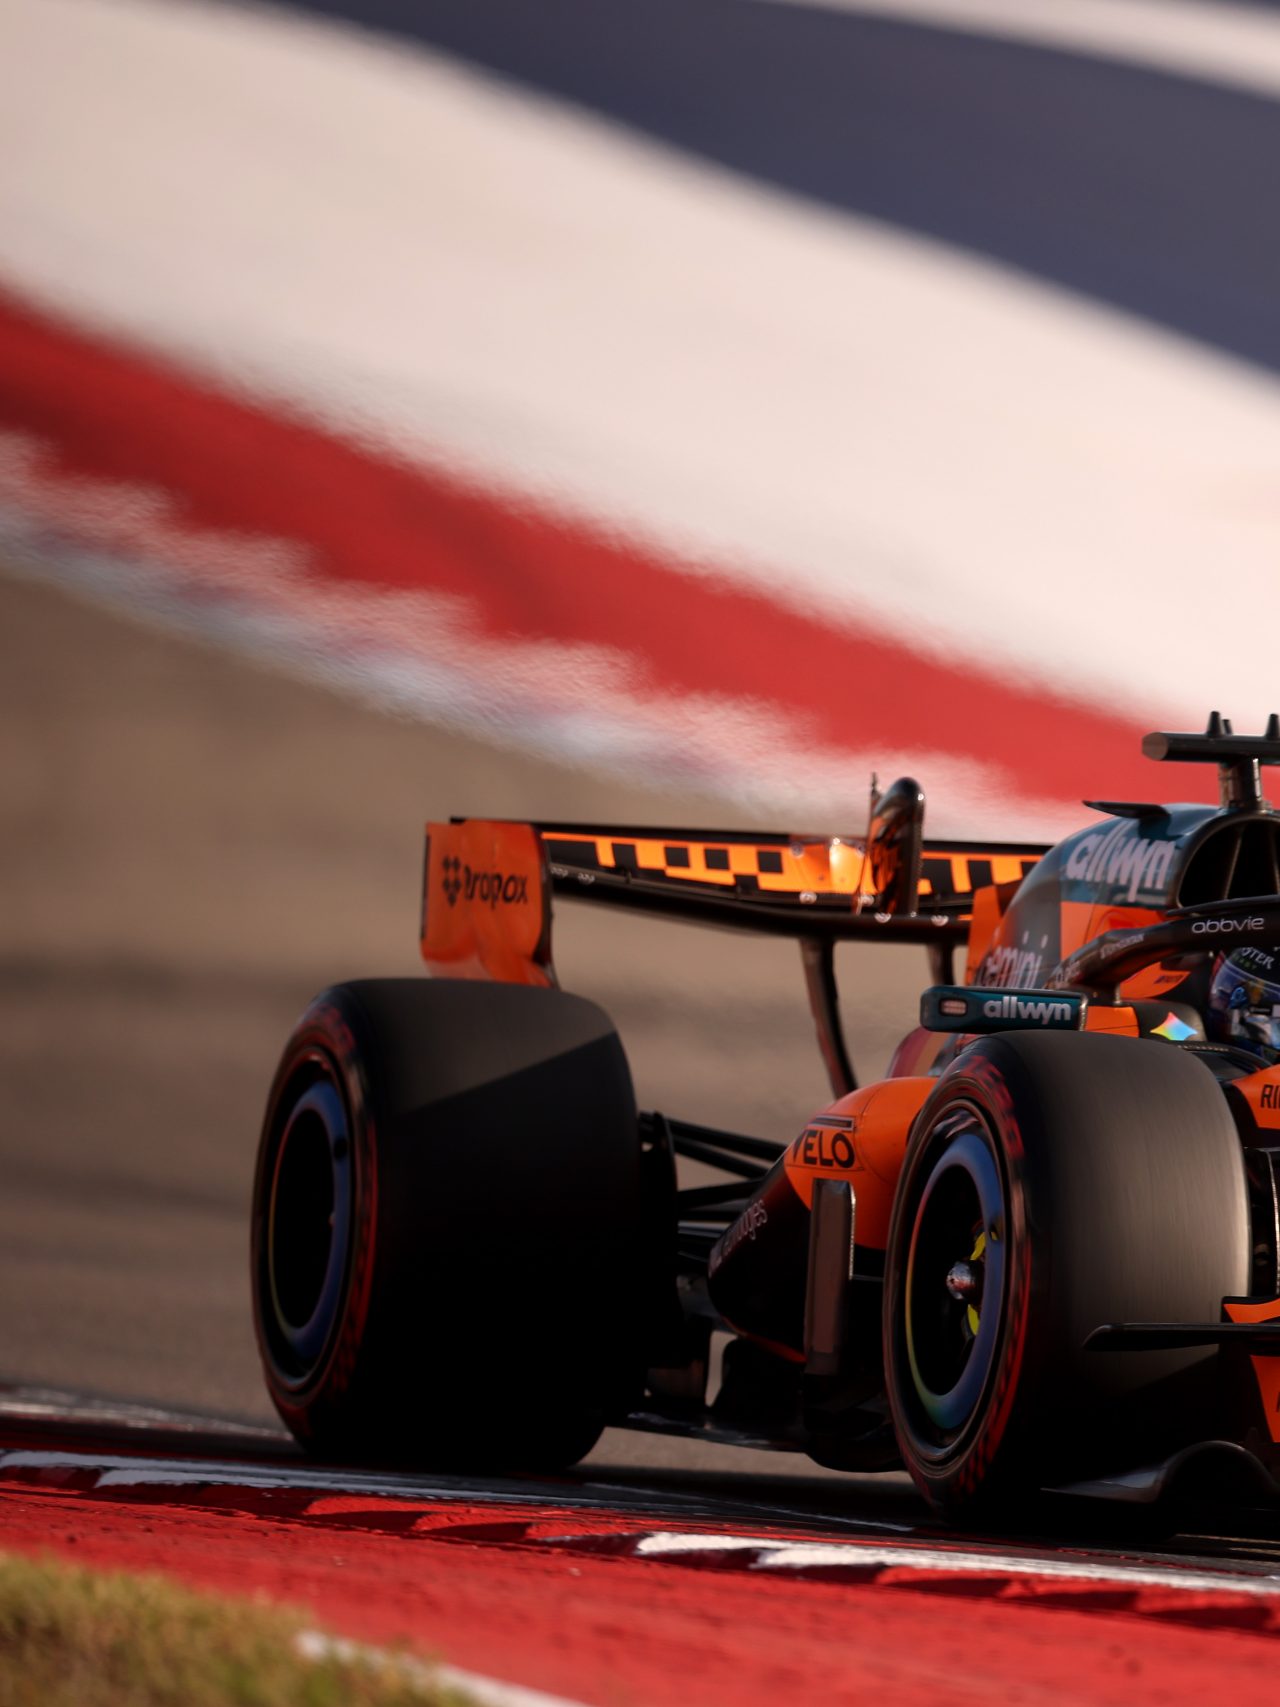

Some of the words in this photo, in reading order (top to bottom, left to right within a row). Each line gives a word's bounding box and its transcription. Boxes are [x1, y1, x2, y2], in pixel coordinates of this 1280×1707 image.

[1065, 820, 1176, 904] allwyn
[1191, 914, 1265, 934] abbvie
[982, 996, 1071, 1025] allwyn
[793, 1128, 857, 1168] VELO
